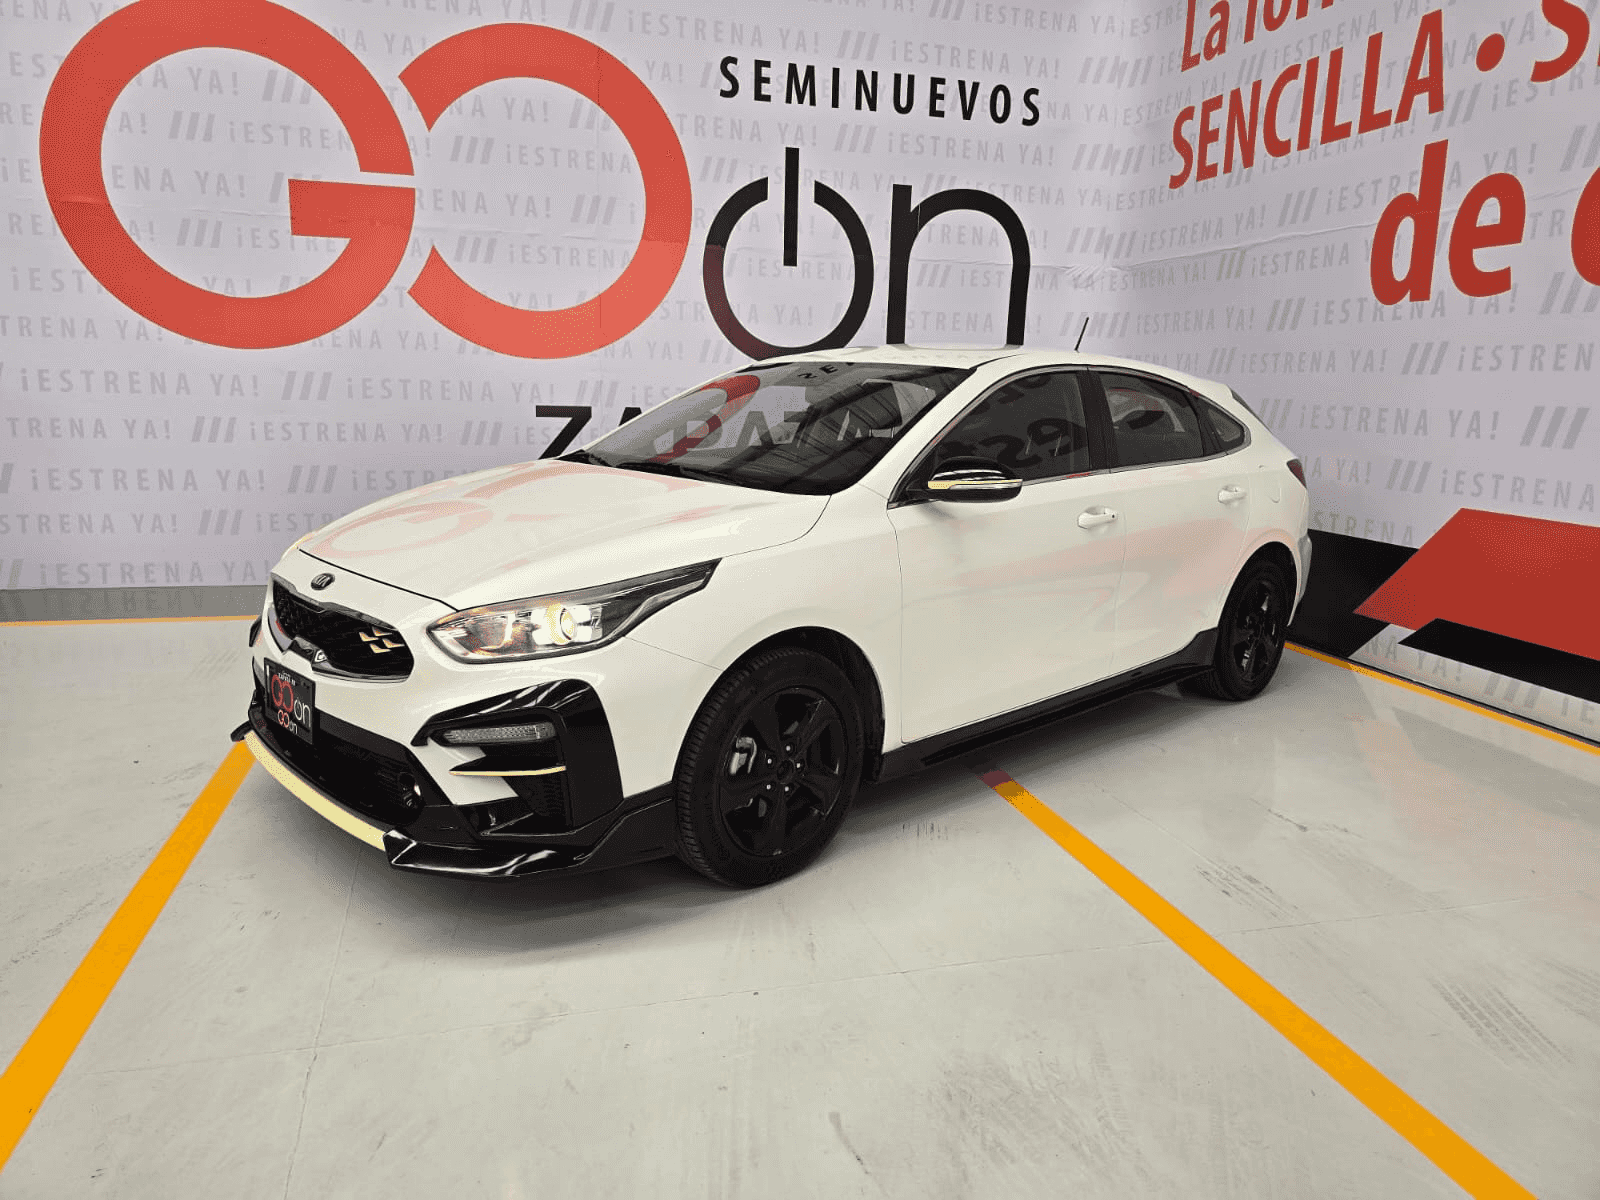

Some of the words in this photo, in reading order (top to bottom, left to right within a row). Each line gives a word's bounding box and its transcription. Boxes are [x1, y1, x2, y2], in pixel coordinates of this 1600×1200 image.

[627, 10, 763, 47] ¡ESTRENA
[778, 28, 819, 53] YA!
[891, 40, 1010, 74] ¡ESTRENA
[1023, 55, 1060, 79] YA!
[187, 66, 239, 96] YA!
[719, 56, 1040, 127] SEMINUEVOS
[503, 96, 549, 122] YA!
[1168, 8, 1444, 190] SENCILLA
[777, 122, 817, 147] YA!
[506, 143, 632, 174] ¡ESTRENA
[888, 131, 1005, 163] ¡ESTRENA
[1019, 143, 1055, 167] YA!
[194, 170, 246, 198] YA!
[505, 193, 551, 219] YA!
[1235, 203, 1266, 236] YA!
[1370, 139, 1526, 306] de
[774, 304, 814, 326] YA!
[1225, 305, 1256, 331] YA!
[398, 330, 439, 351] YA!
[646, 340, 684, 360] YA!
[1350, 348, 1388, 373] YA!
[20, 367, 191, 396] ¡ESTRENA
[209, 372, 260, 397] YA!
[347, 376, 494, 402] ¡ESTRENA
[511, 381, 555, 404] YA!
[123, 418, 171, 440] YA!
[250, 420, 387, 443] ¡ESTRENA
[401, 422, 443, 443] YA!
[1300, 404, 1429, 436] ¡ESTRENA
[1448, 409, 1500, 441] YA!
[30, 467, 199, 492] ¡ESTRENA
[215, 468, 266, 492] YA!
[1335, 458, 1373, 485] YA!
[1440, 468, 1596, 512] ¡ESTRENA
[131, 513, 178, 535] YA!
